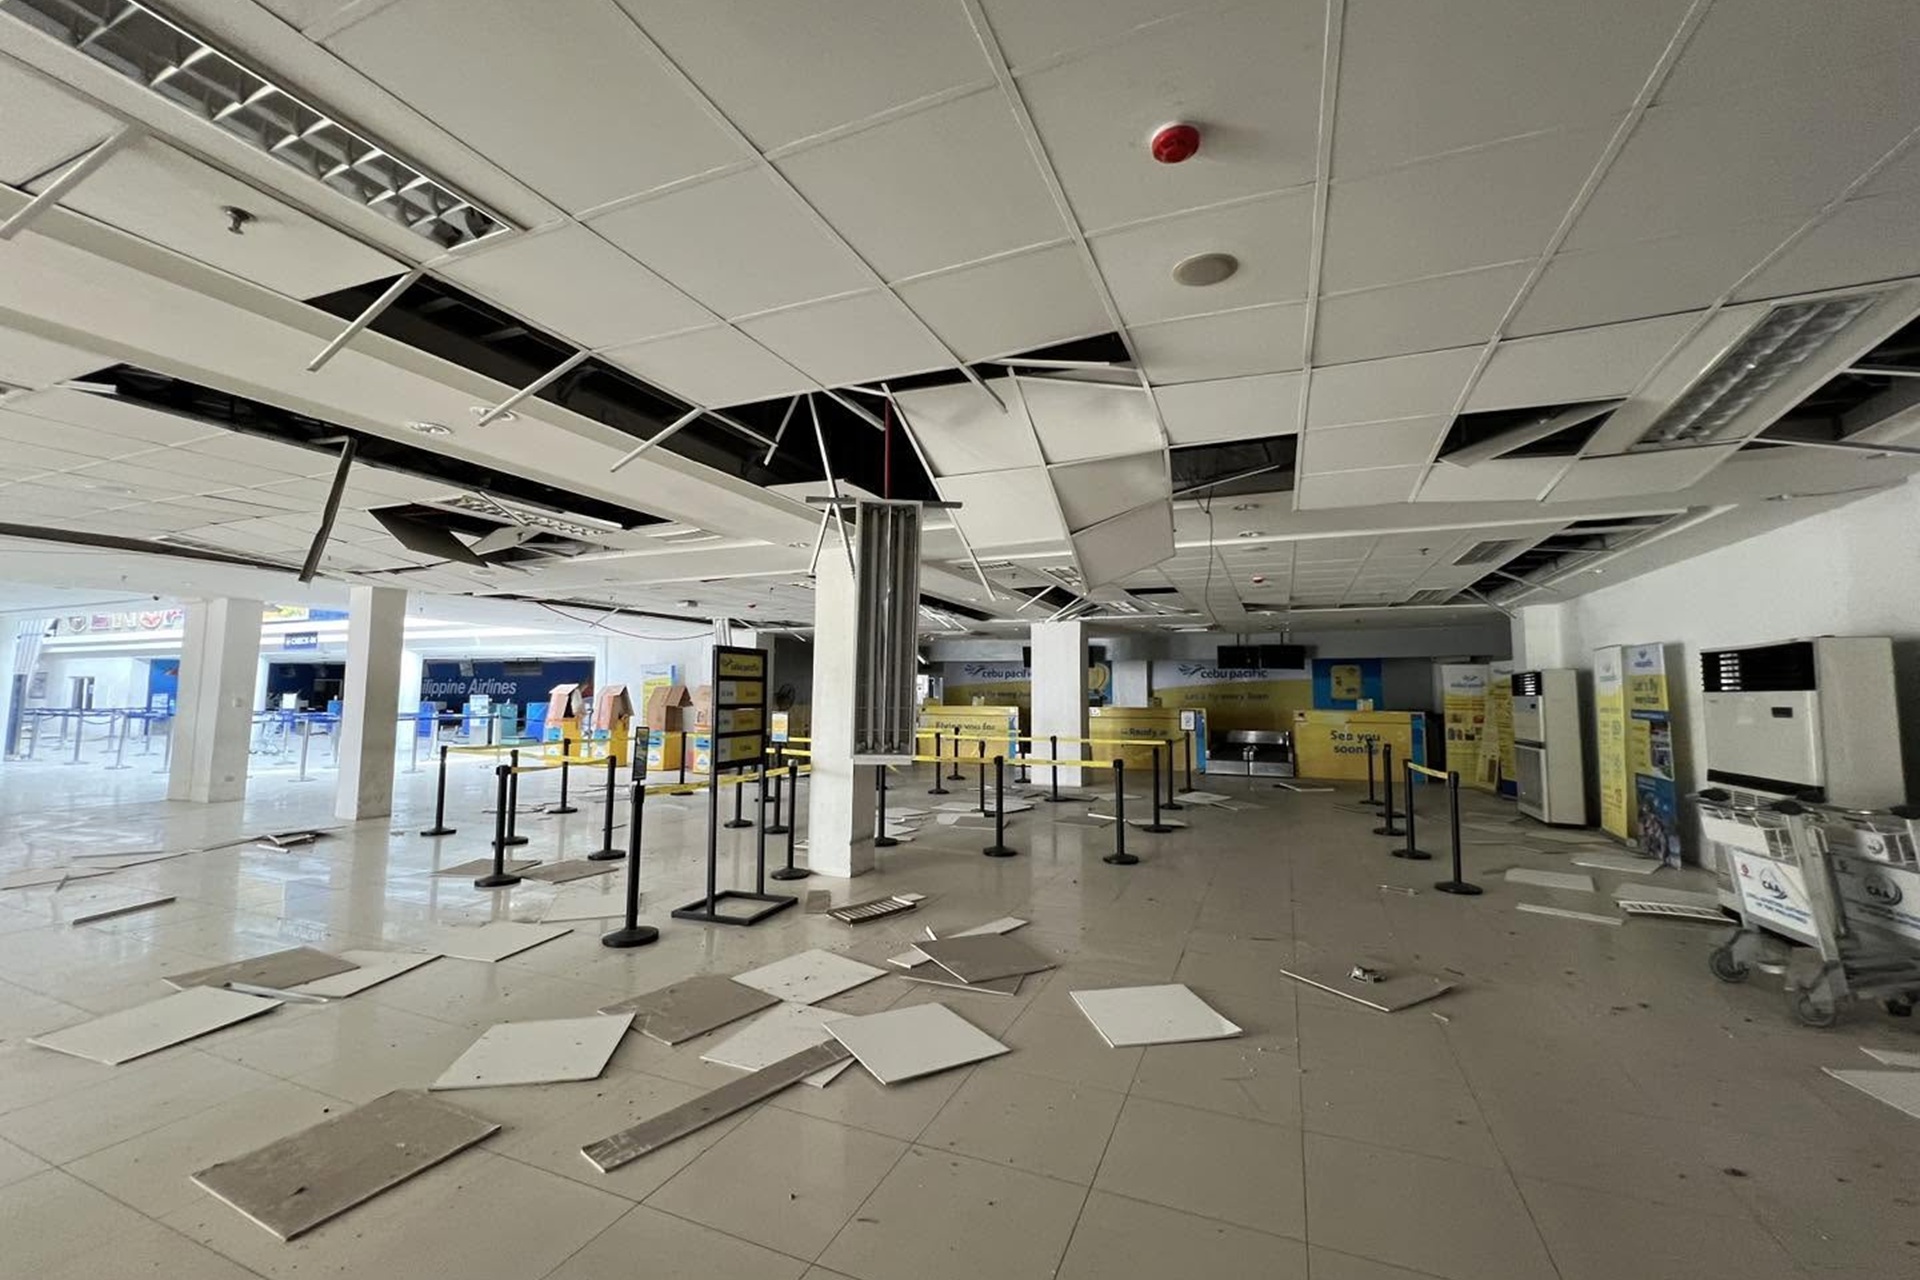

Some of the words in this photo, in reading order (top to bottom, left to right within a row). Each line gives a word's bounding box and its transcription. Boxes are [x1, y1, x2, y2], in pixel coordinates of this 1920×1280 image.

[982, 668, 1003, 678] cebu
[1004, 669, 1031, 680] pacifi
[1200, 668, 1227, 678] cebu
[1229, 668, 1268, 681] pacific
[467, 678, 517, 694] Airlines
[1330, 730, 1353, 741] See
[1357, 733, 1380, 744] you
